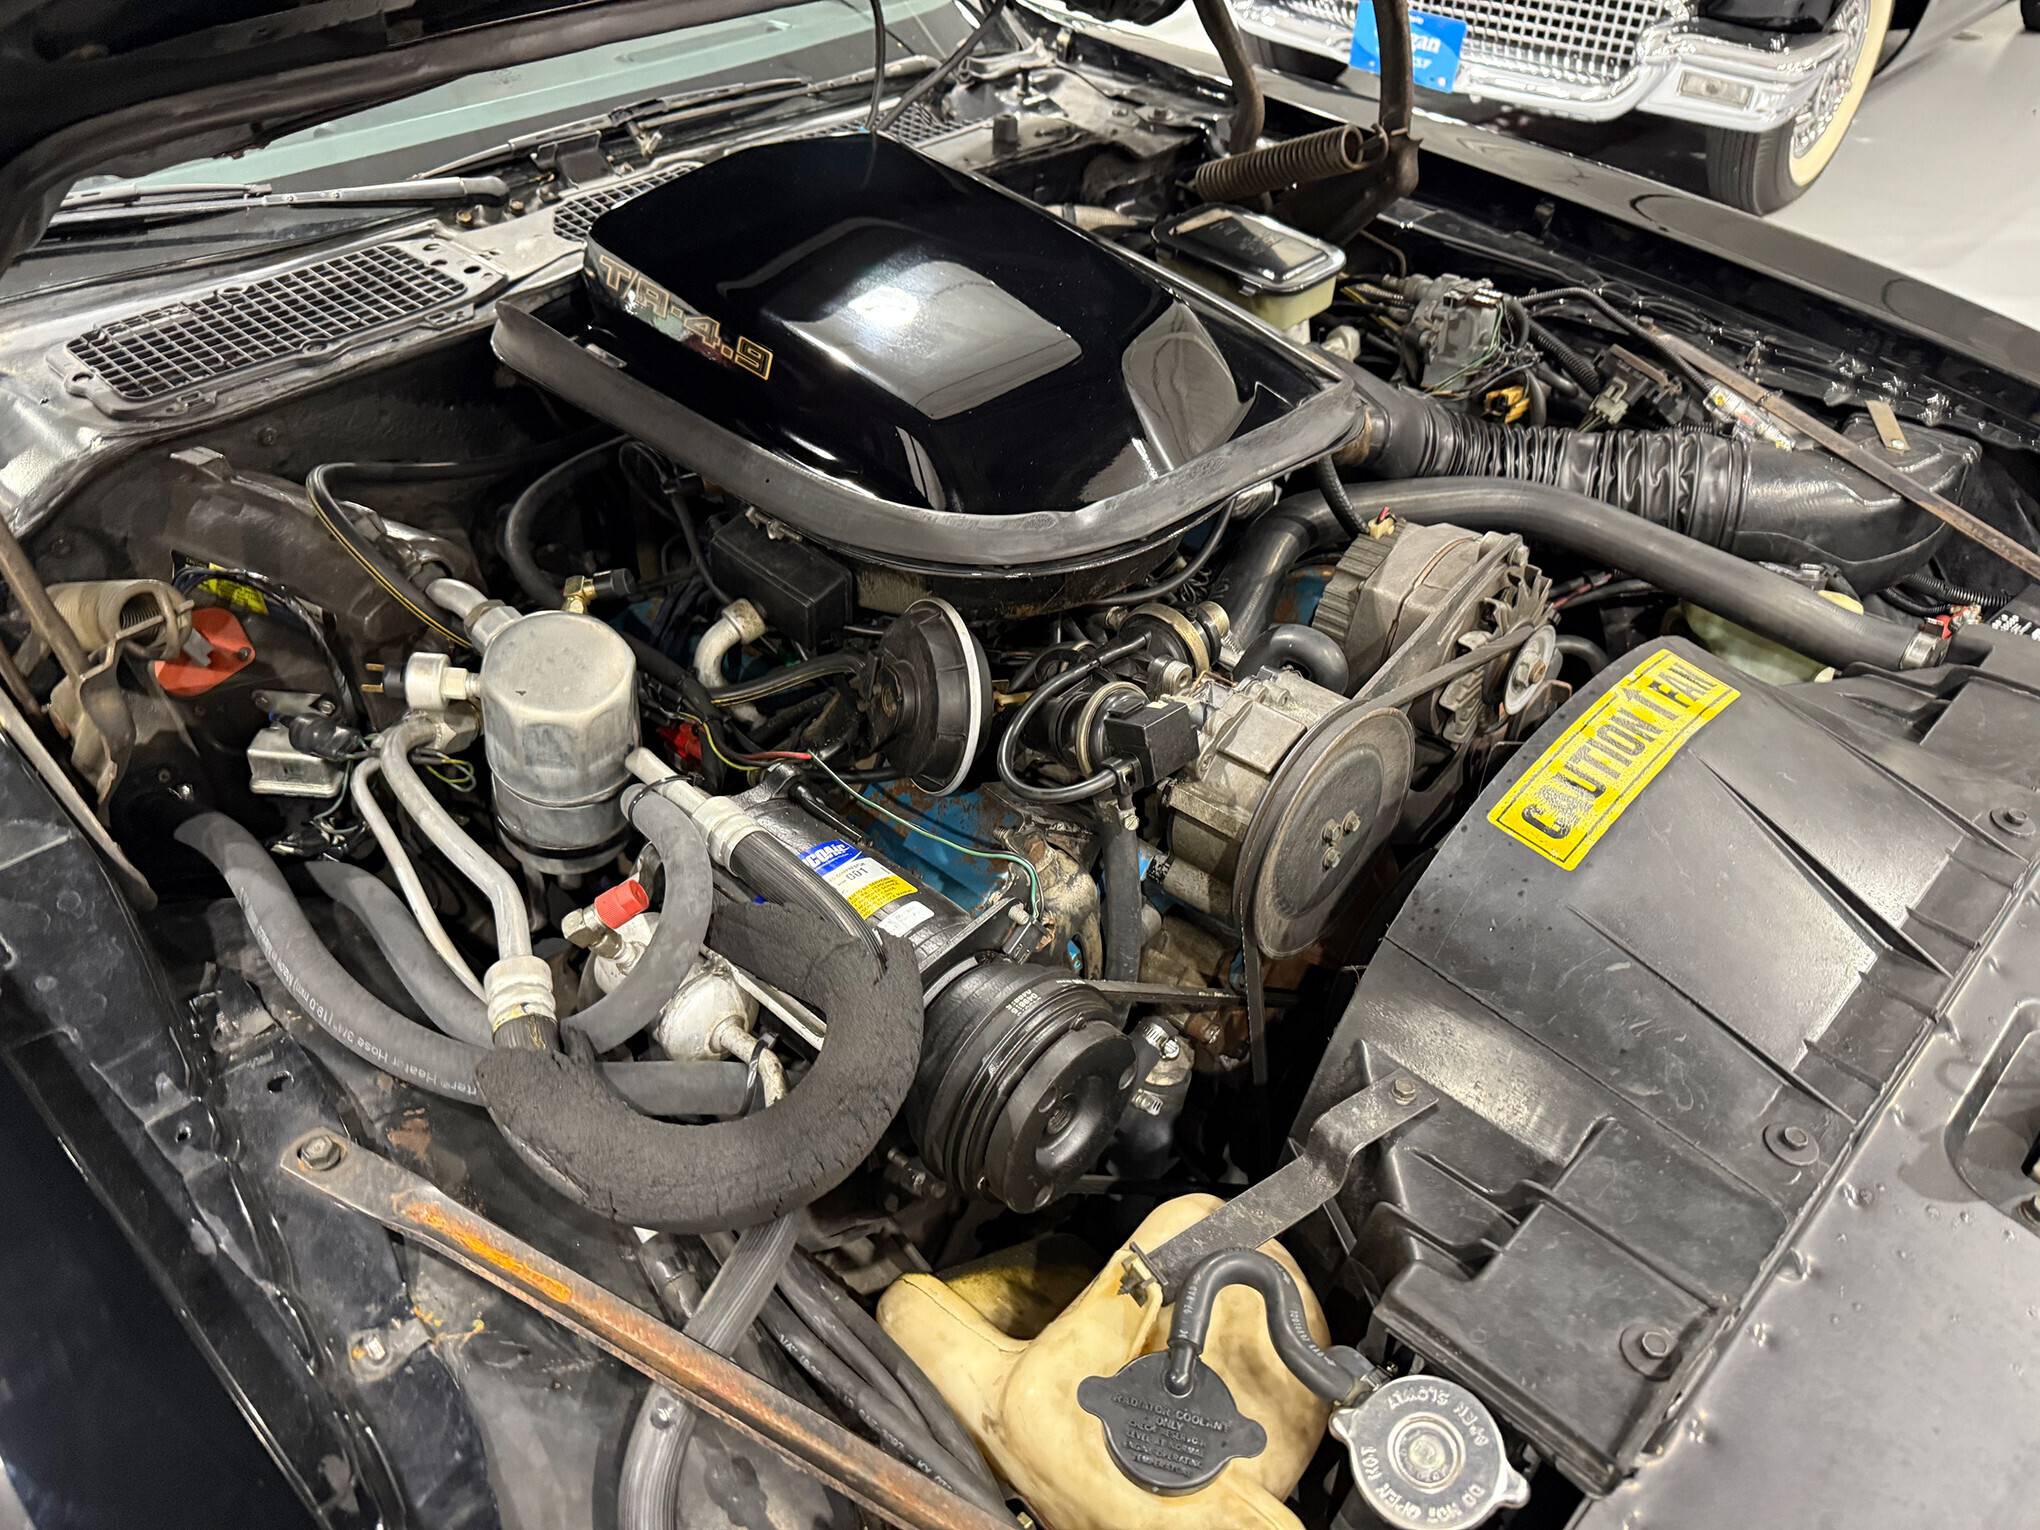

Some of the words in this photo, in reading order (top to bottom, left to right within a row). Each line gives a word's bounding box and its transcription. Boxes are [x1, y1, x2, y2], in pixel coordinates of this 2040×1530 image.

[1522, 707, 1664, 838] CAUTION
[1649, 663, 1718, 709] FAN
[356, 1036, 388, 1063] Hose
[1387, 1386, 1450, 1411] SLOWLY
[1111, 1393, 1171, 1417] RADIATOR
[1175, 1410, 1231, 1433] COOLANT
[1156, 1416, 1184, 1431] ONLY
[1360, 1446, 1383, 1481] HOT
[1375, 1483, 1422, 1521] OPEN
[1461, 1484, 1486, 1507] DO
[1427, 1502, 1462, 1523] NOT
